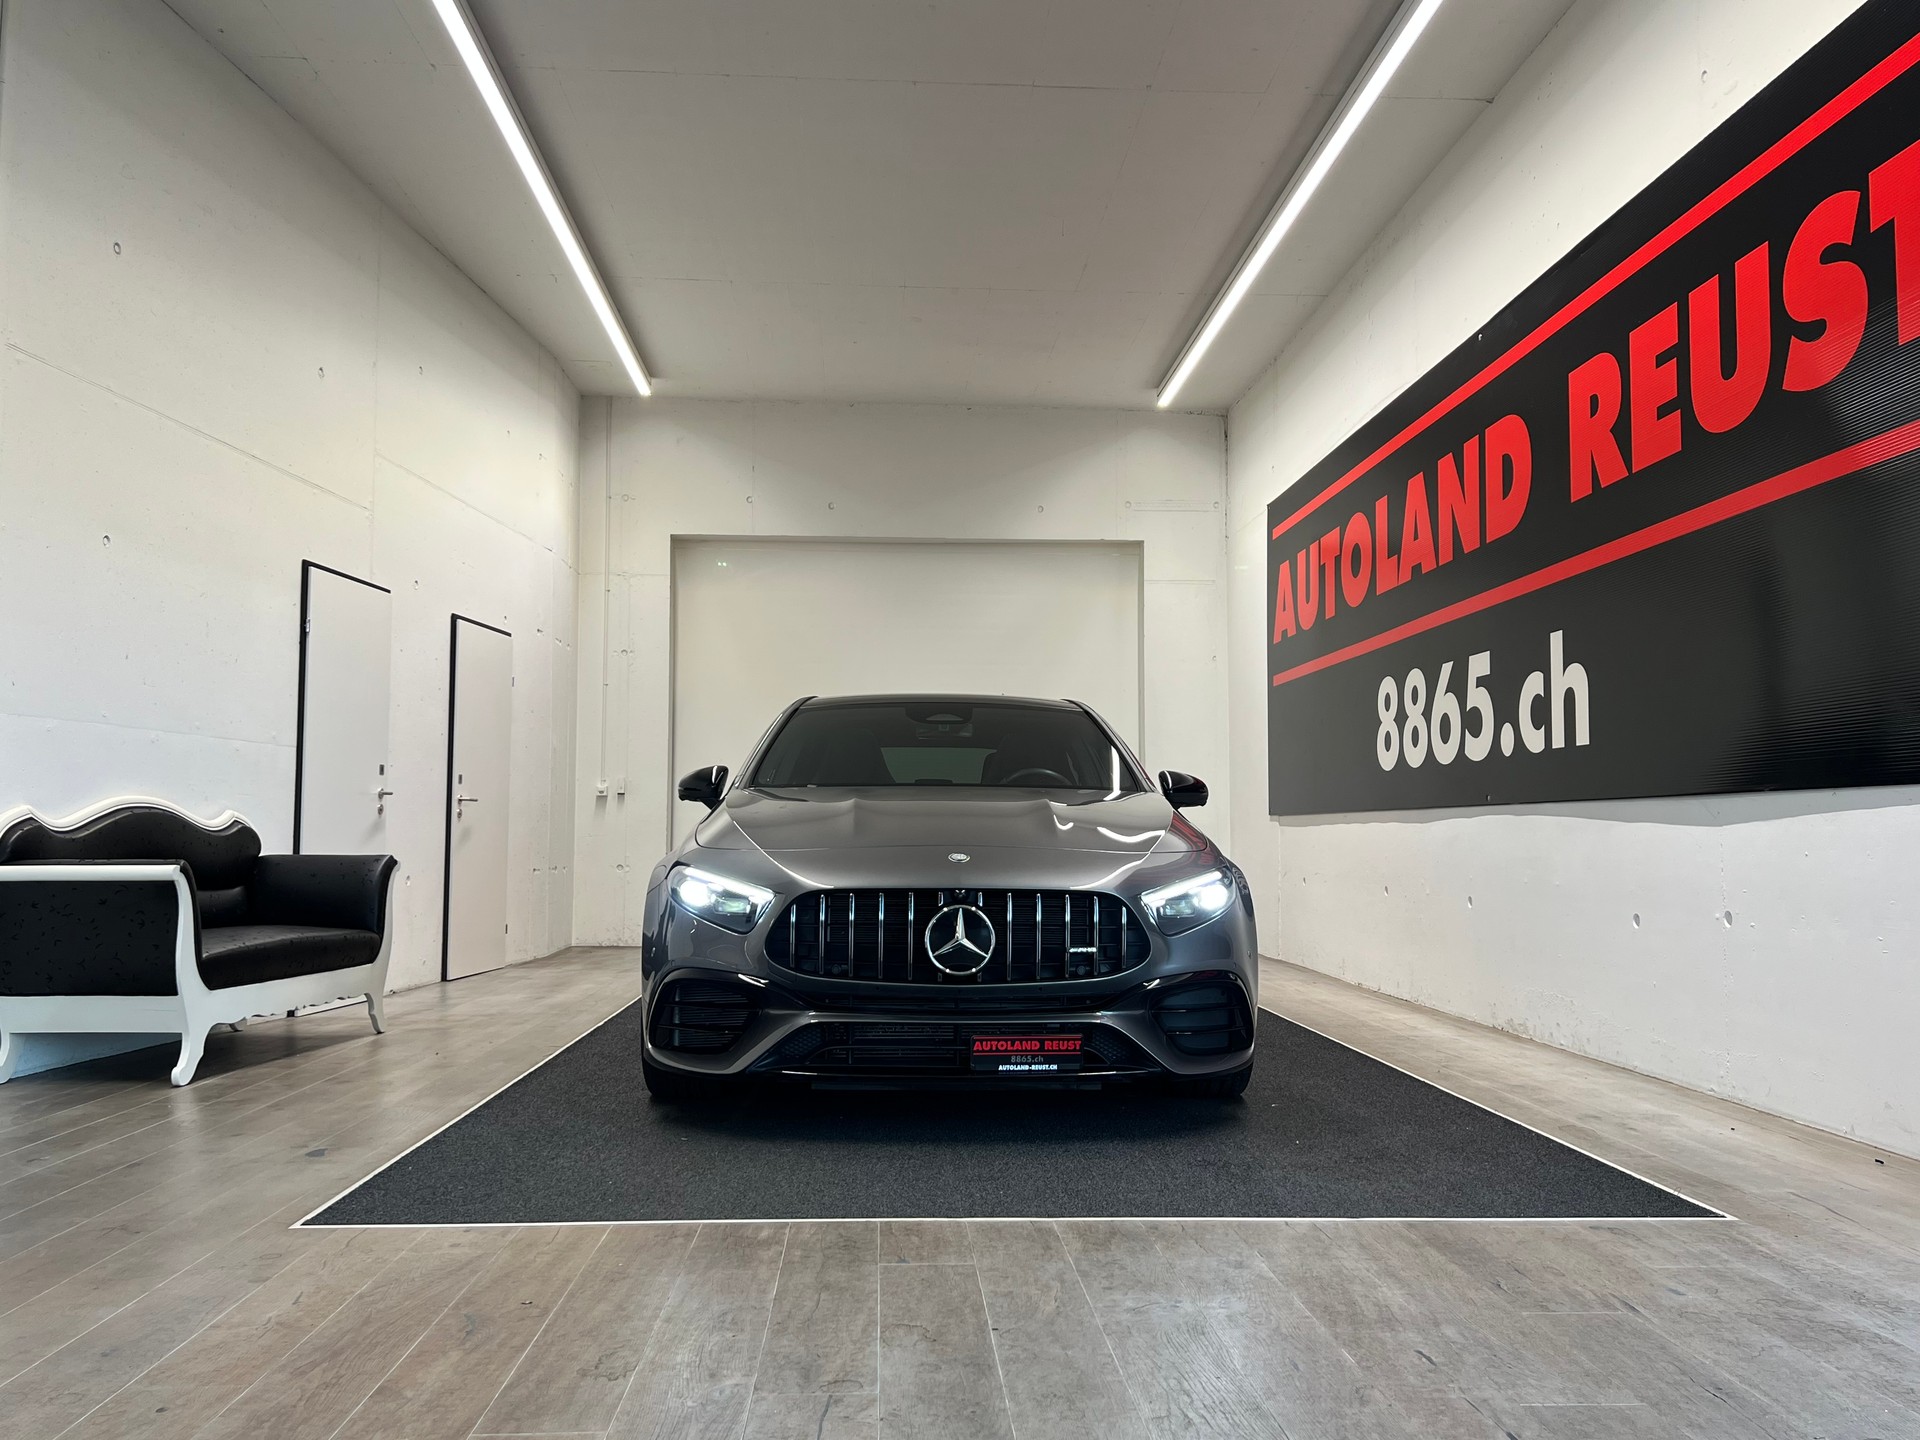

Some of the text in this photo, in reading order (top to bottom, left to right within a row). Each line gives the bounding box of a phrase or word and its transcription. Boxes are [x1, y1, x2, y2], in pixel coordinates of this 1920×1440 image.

[1273, 414, 1533, 644] AUTOLAND
[1376, 629, 1590, 772] 8865.ch
[973, 1040, 1082, 1051] AUTOLAND REUST
[1010, 1055, 1044, 1063] 8865.ch
